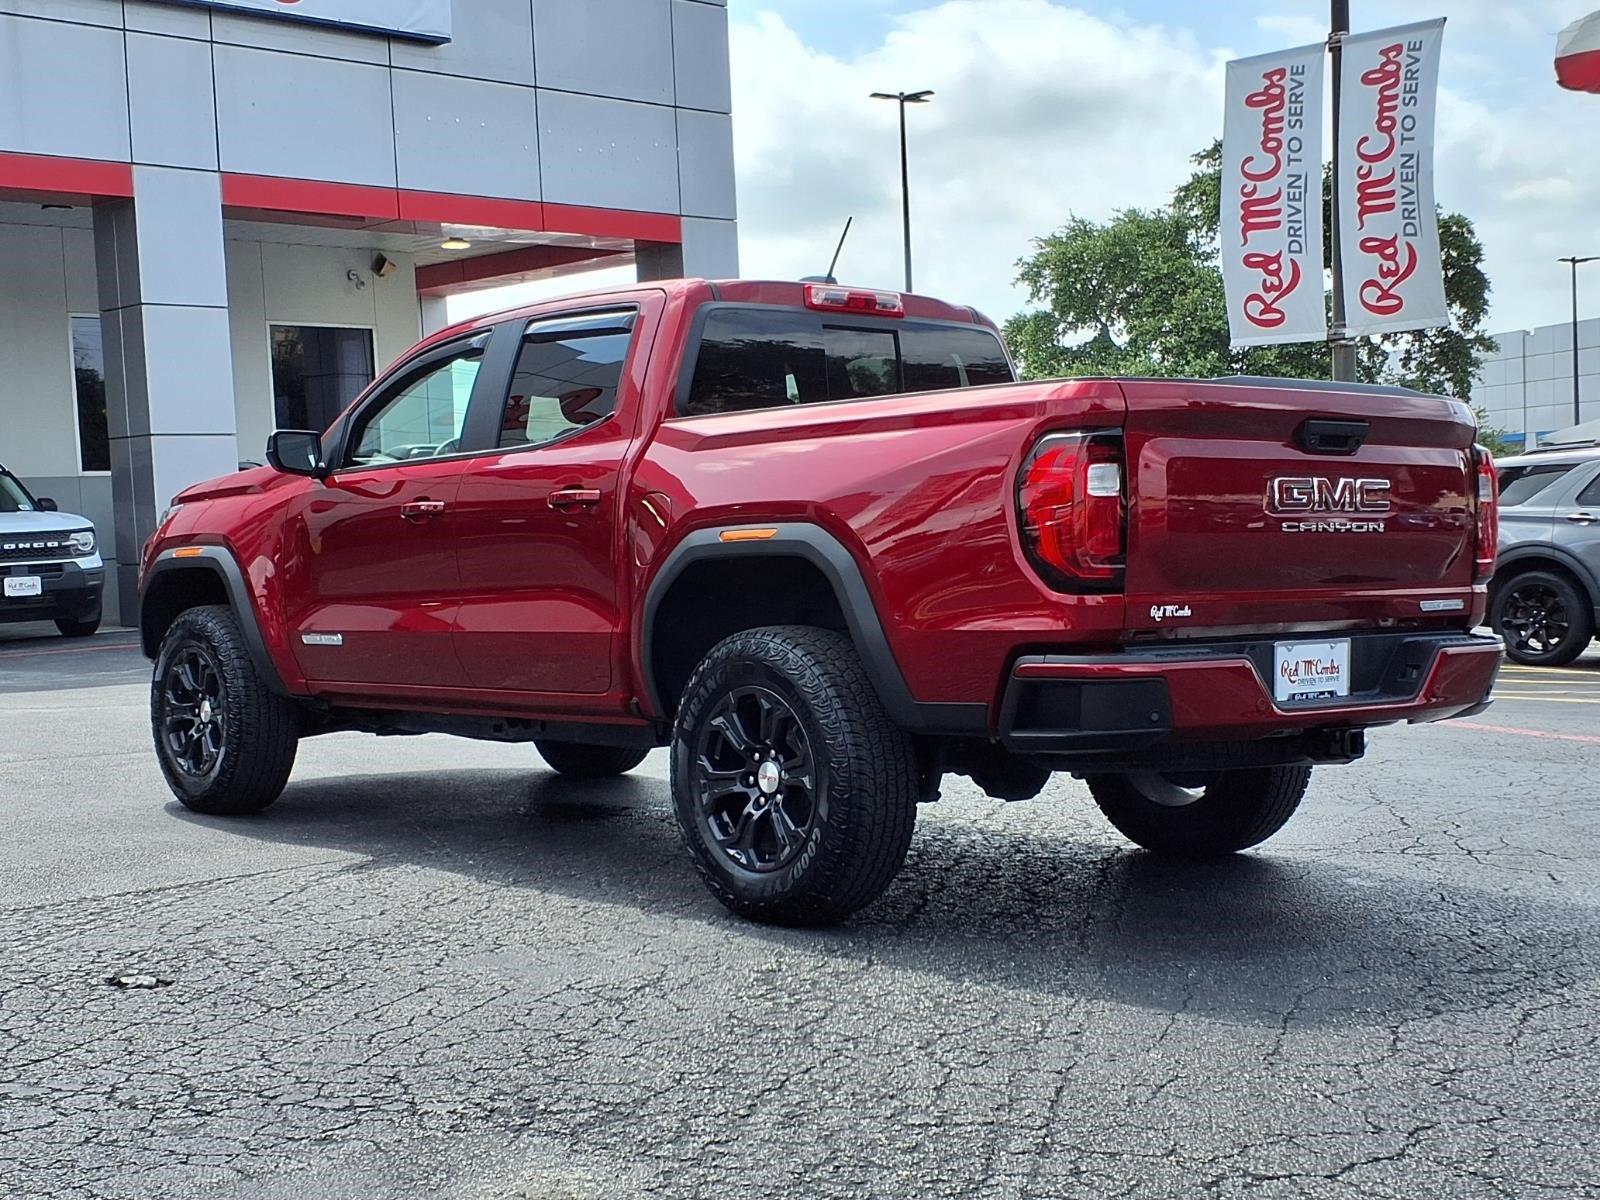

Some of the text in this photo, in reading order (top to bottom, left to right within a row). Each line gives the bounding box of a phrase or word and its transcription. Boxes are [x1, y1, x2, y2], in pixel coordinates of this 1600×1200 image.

[1287, 64, 1305, 254] DRIVEN TO SERVE
[1356, 43, 1418, 316] Red McCombs
[1400, 40, 1422, 238] DRIVEN TO SERVE
[1239, 67, 1300, 328] Red McCombs
[0, 541, 59, 550] ONCO
[1273, 477, 1391, 511] GMC
[1282, 521, 1385, 532] CANYON
[1281, 658, 1339, 684] Red McCombs
